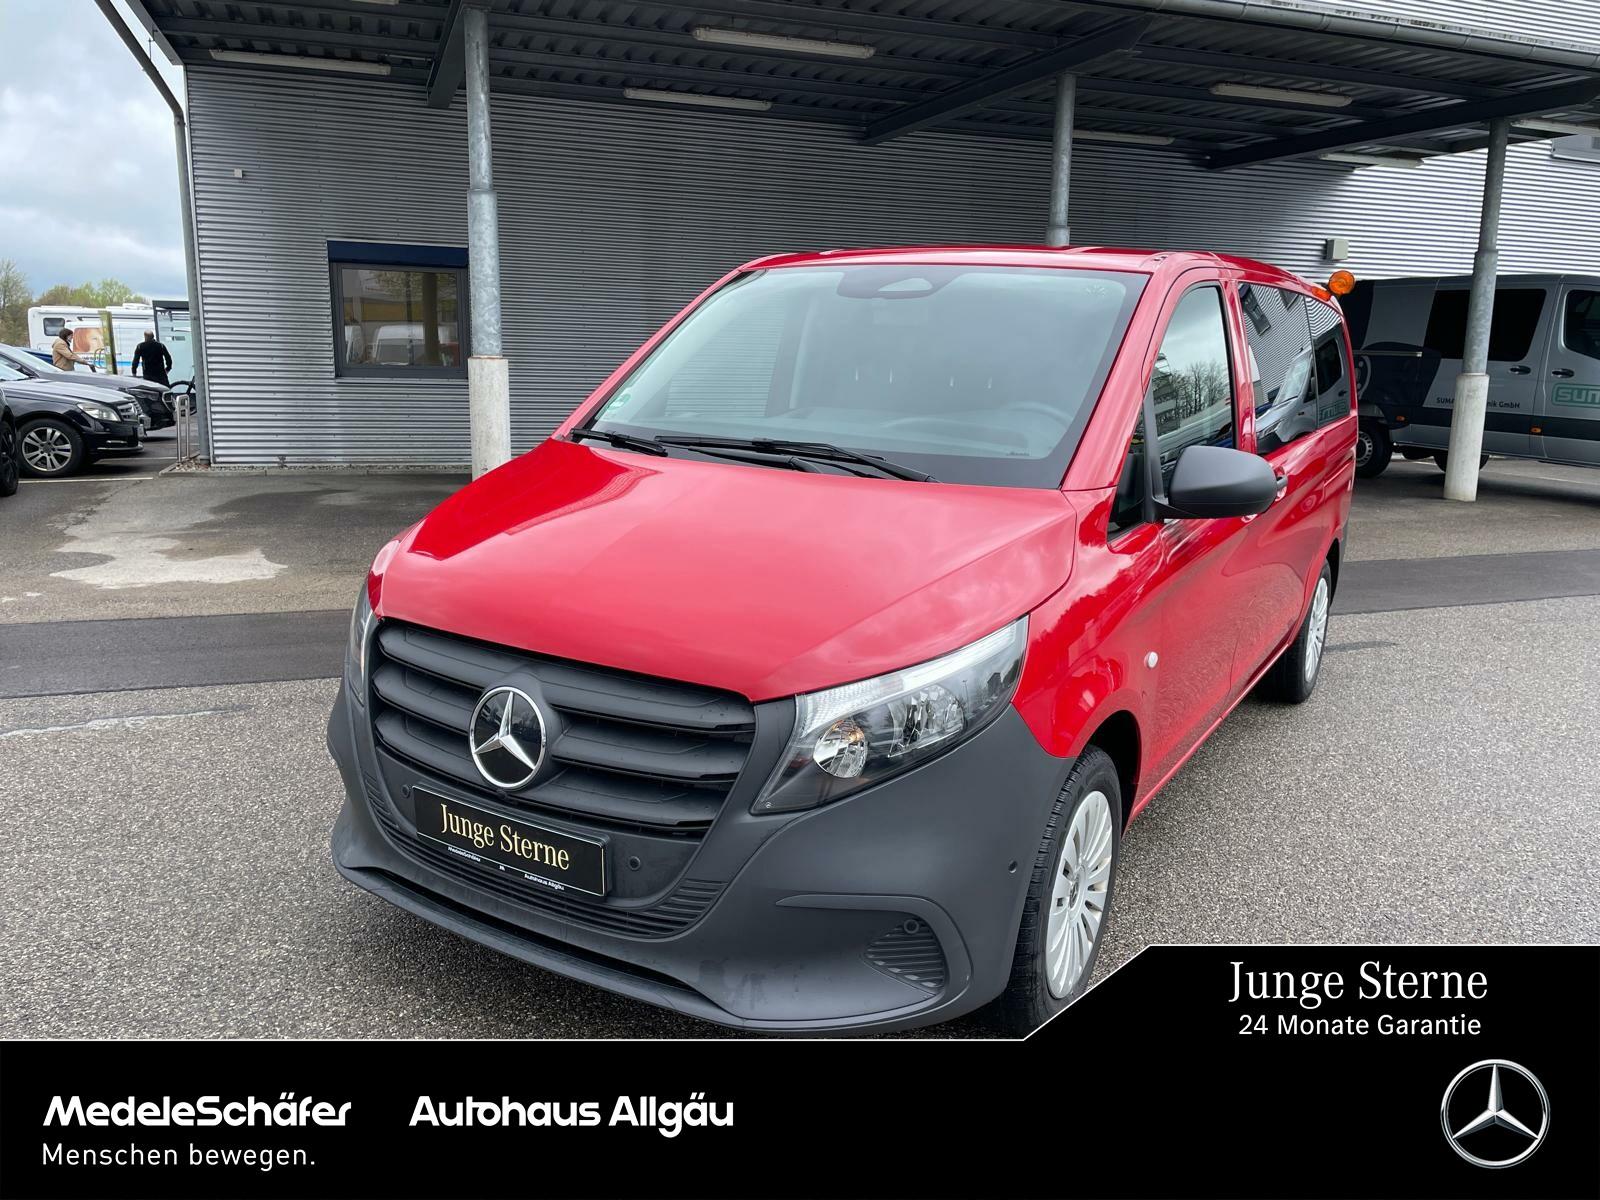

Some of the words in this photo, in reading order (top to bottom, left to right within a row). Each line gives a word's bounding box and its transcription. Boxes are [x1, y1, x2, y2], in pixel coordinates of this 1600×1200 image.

[1499, 401, 1521, 409] GmbH
[440, 803, 495, 849] Junge
[500, 825, 570, 870] Sterne
